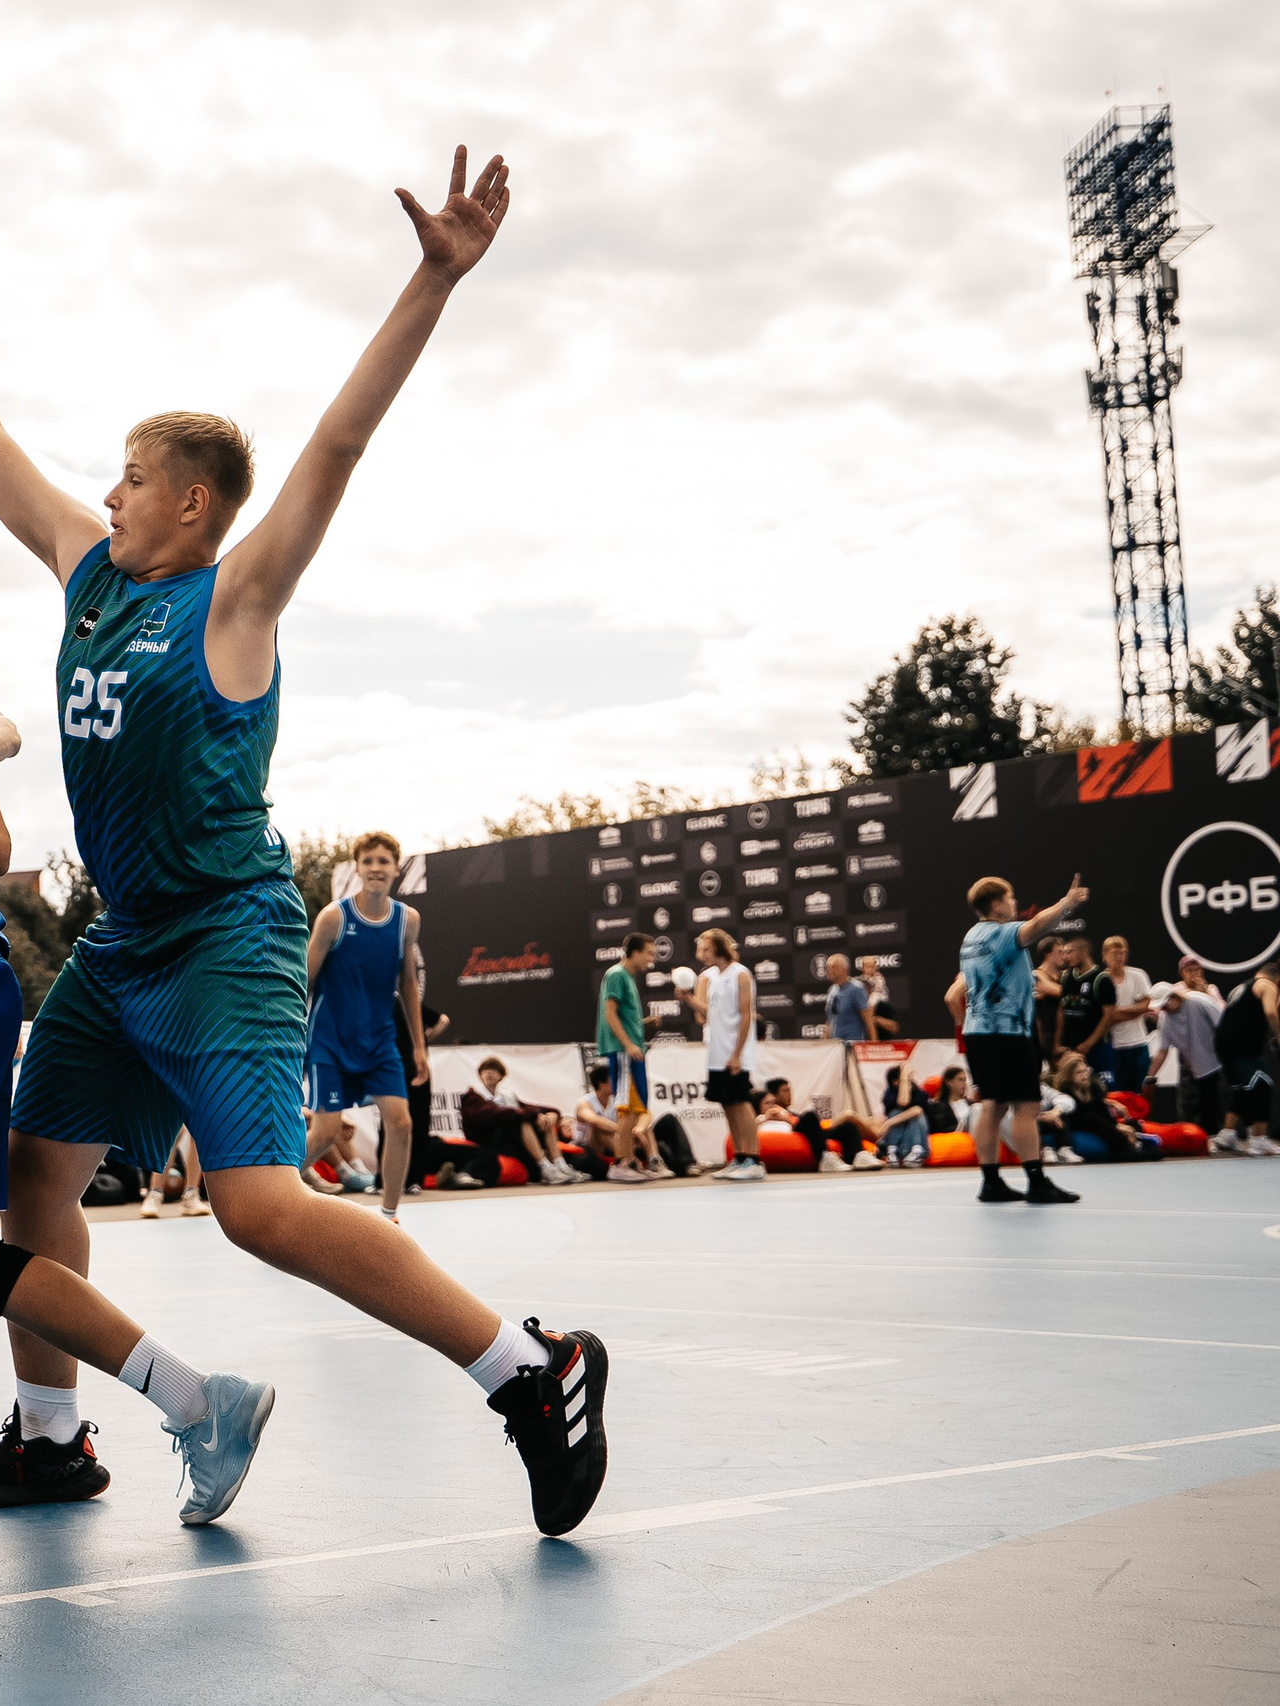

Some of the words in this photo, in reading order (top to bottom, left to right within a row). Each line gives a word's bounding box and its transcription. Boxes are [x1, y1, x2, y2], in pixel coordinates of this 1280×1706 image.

[125, 638, 170, 653] ЗЁРНЫЙ
[64, 666, 129, 740] 25
[1178, 874, 1280, 917] РФБ
